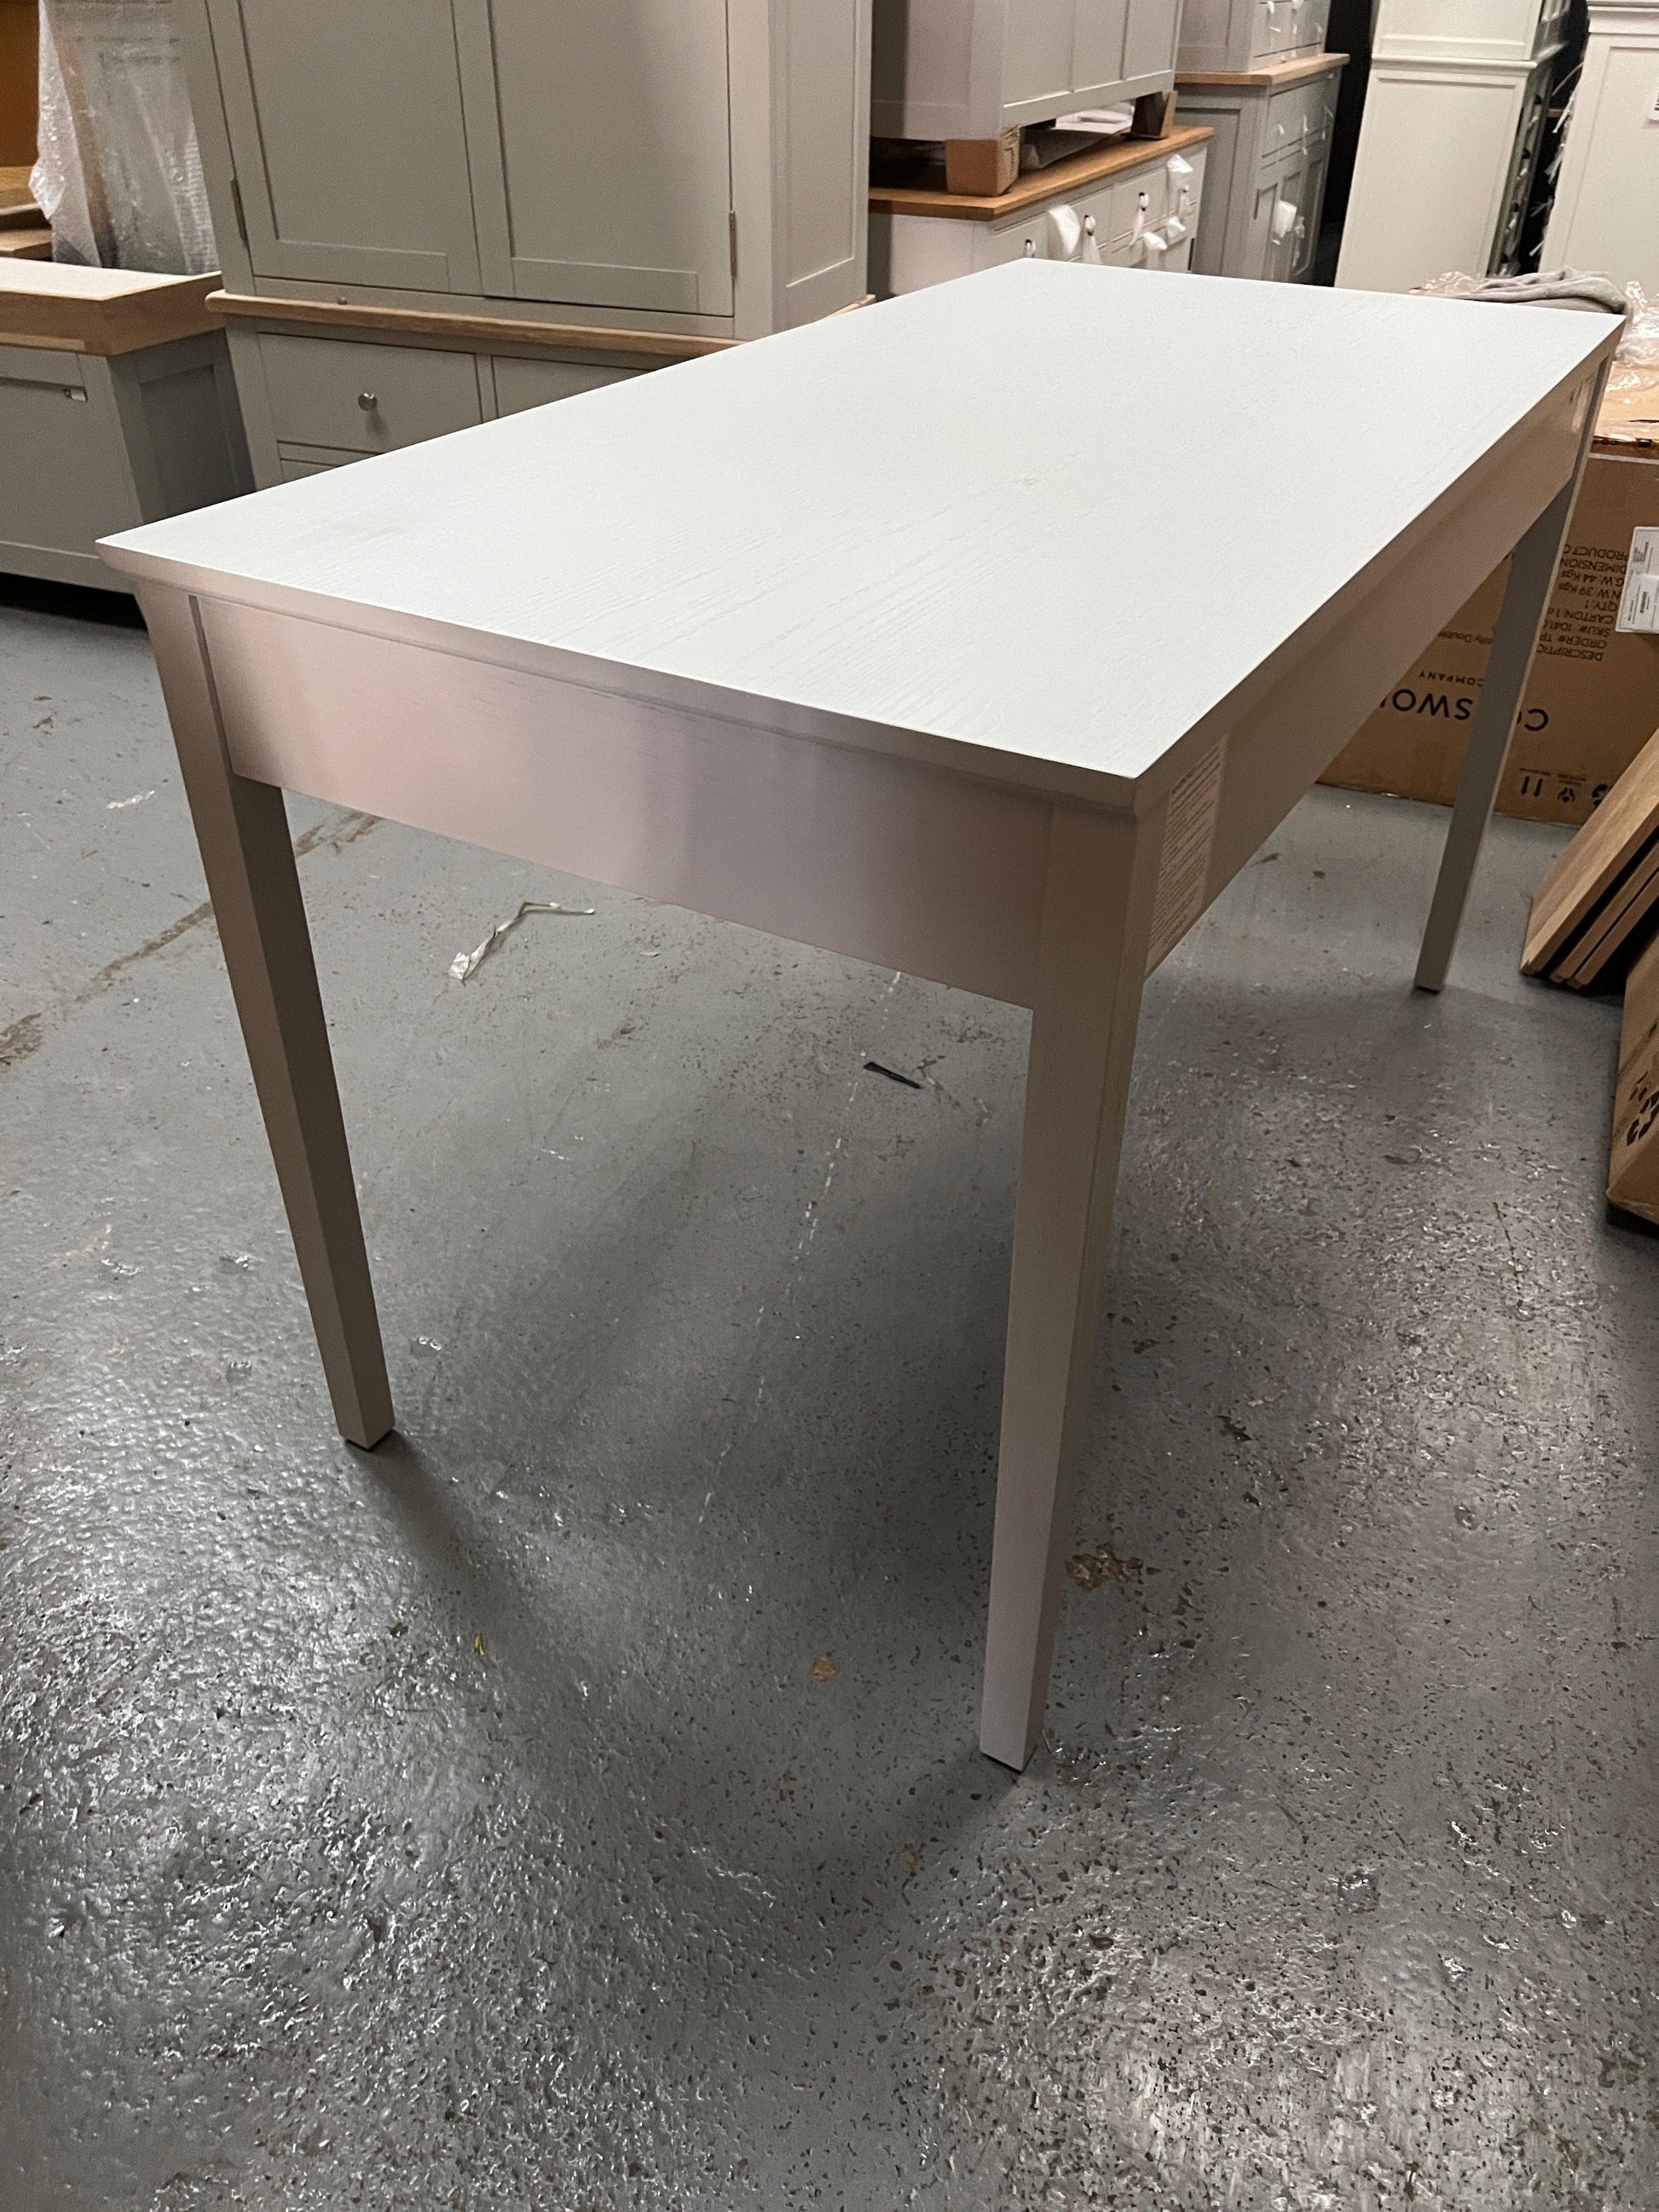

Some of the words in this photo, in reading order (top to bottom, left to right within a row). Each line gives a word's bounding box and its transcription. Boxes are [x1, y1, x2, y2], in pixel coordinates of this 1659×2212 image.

[1560, 557, 1627, 575] DIMENSION
[1583, 575, 1597, 583] 44
[1579, 586, 1593, 596] 39
[1540, 632, 1552, 642] TP
[1536, 644, 1604, 661] DESCRIPTIO
[1419, 671, 1484, 687] COMPANY
